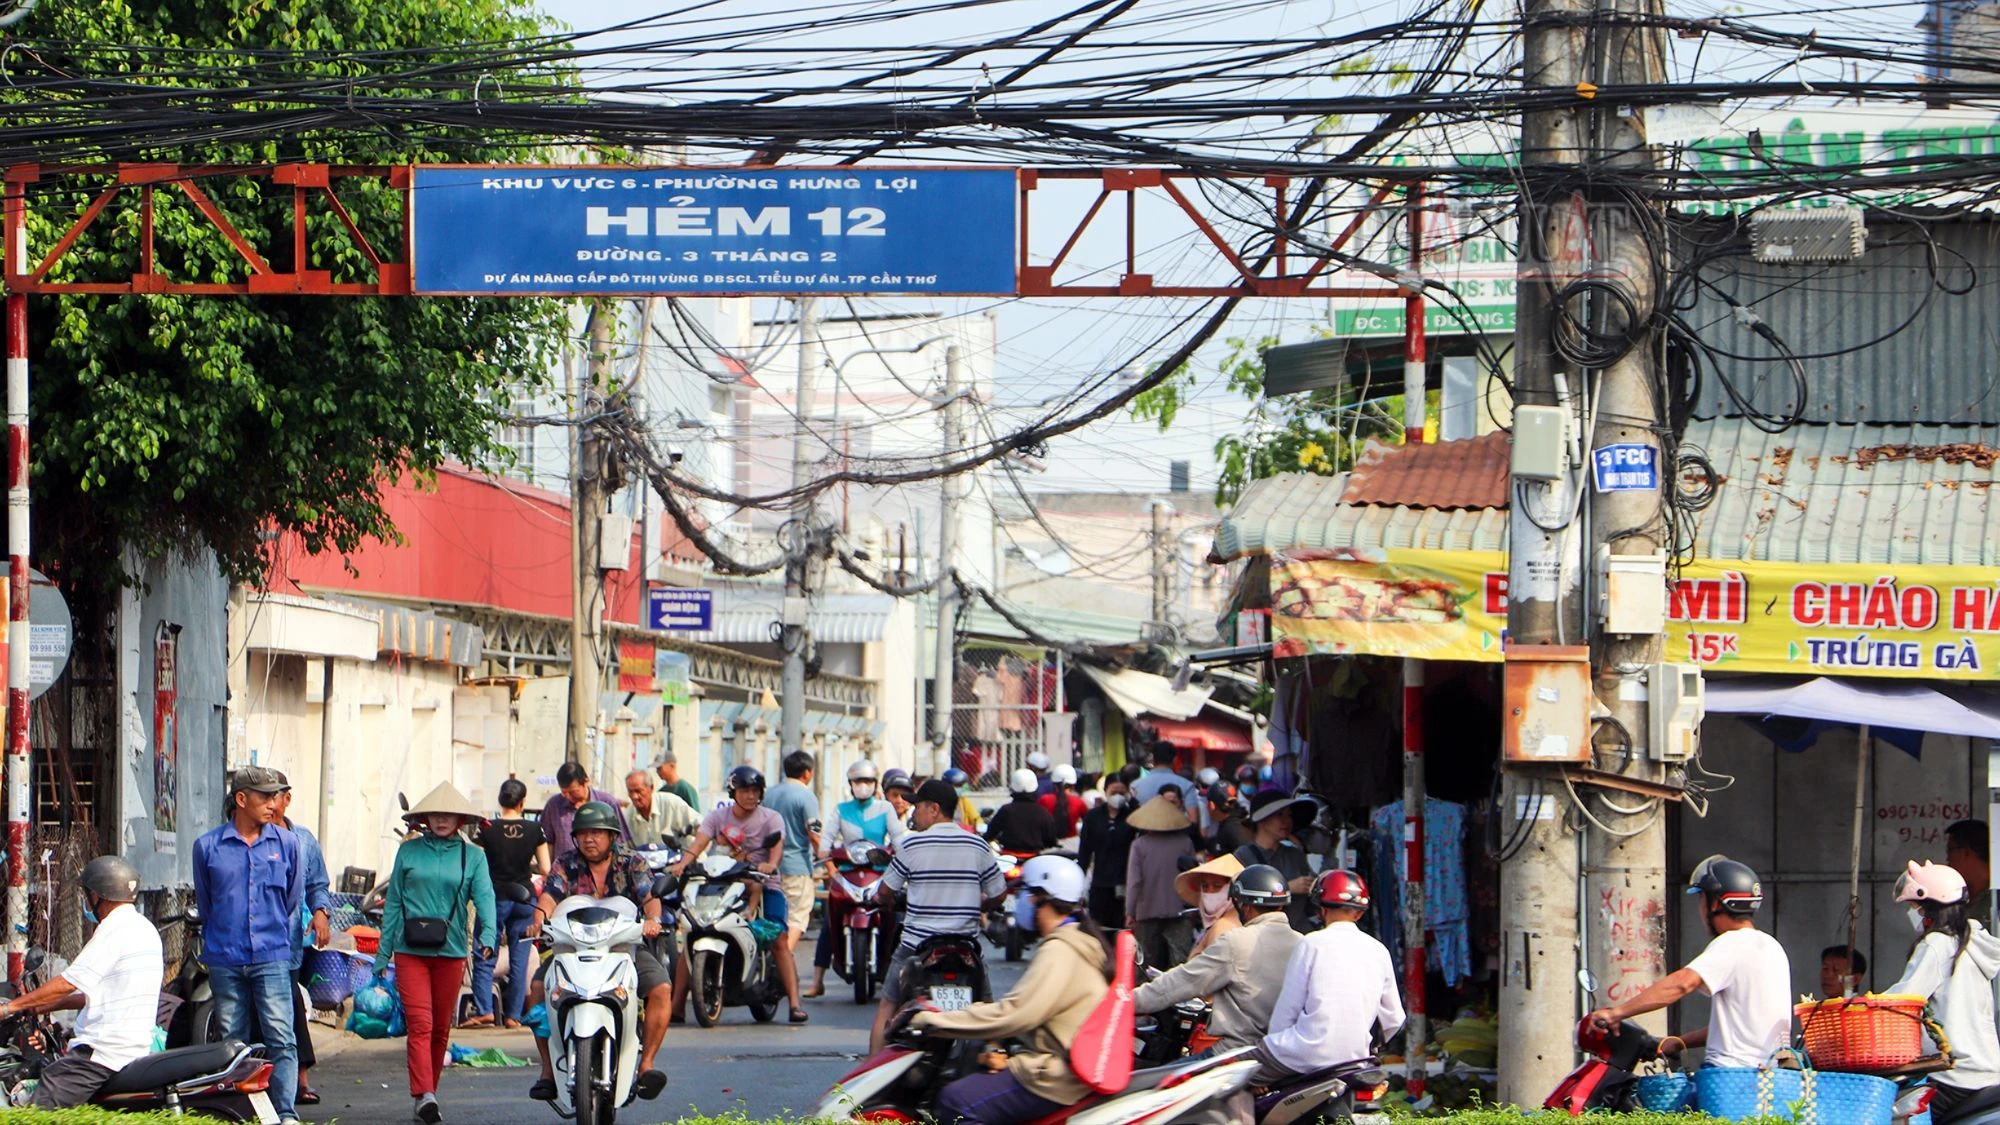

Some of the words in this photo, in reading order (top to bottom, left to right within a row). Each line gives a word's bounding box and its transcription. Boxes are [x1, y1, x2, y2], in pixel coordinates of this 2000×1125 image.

[482, 178, 544, 190] KHU
[552, 176, 616, 192] VỰC
[621, 178, 636, 189] 6
[655, 174, 778, 190] PHƯỜNG
[789, 177, 861, 190] HƯNG
[875, 178, 917, 193] LỢI
[587, 195, 790, 236] HẺM
[808, 206, 886, 236] 12
[682, 250, 698, 262] 3
[711, 248, 809, 262] THÁNG
[821, 250, 837, 262] 2
[484, 273, 506, 285] DỰ
[510, 273, 531, 284] ÁN
[533, 273, 574, 284] NÂNG
[577, 271, 607, 284] CẤP
[609, 272, 630, 284] ĐÔ
[632, 274, 656, 285] THỊ
[658, 273, 699, 284] VÙNG
[794, 274, 816, 286] DỰ
[870, 271, 901, 285] CẦN
[905, 273, 937, 284] THƠ
[1600, 451, 1612, 467] 3
[1667, 572, 1746, 622] MÌ
[1792, 576, 1937, 630] CHÁO
[1687, 632, 1737, 662] 15K
[1807, 634, 1919, 668] TRỨNG
[1934, 637, 1979, 670] GÀ
